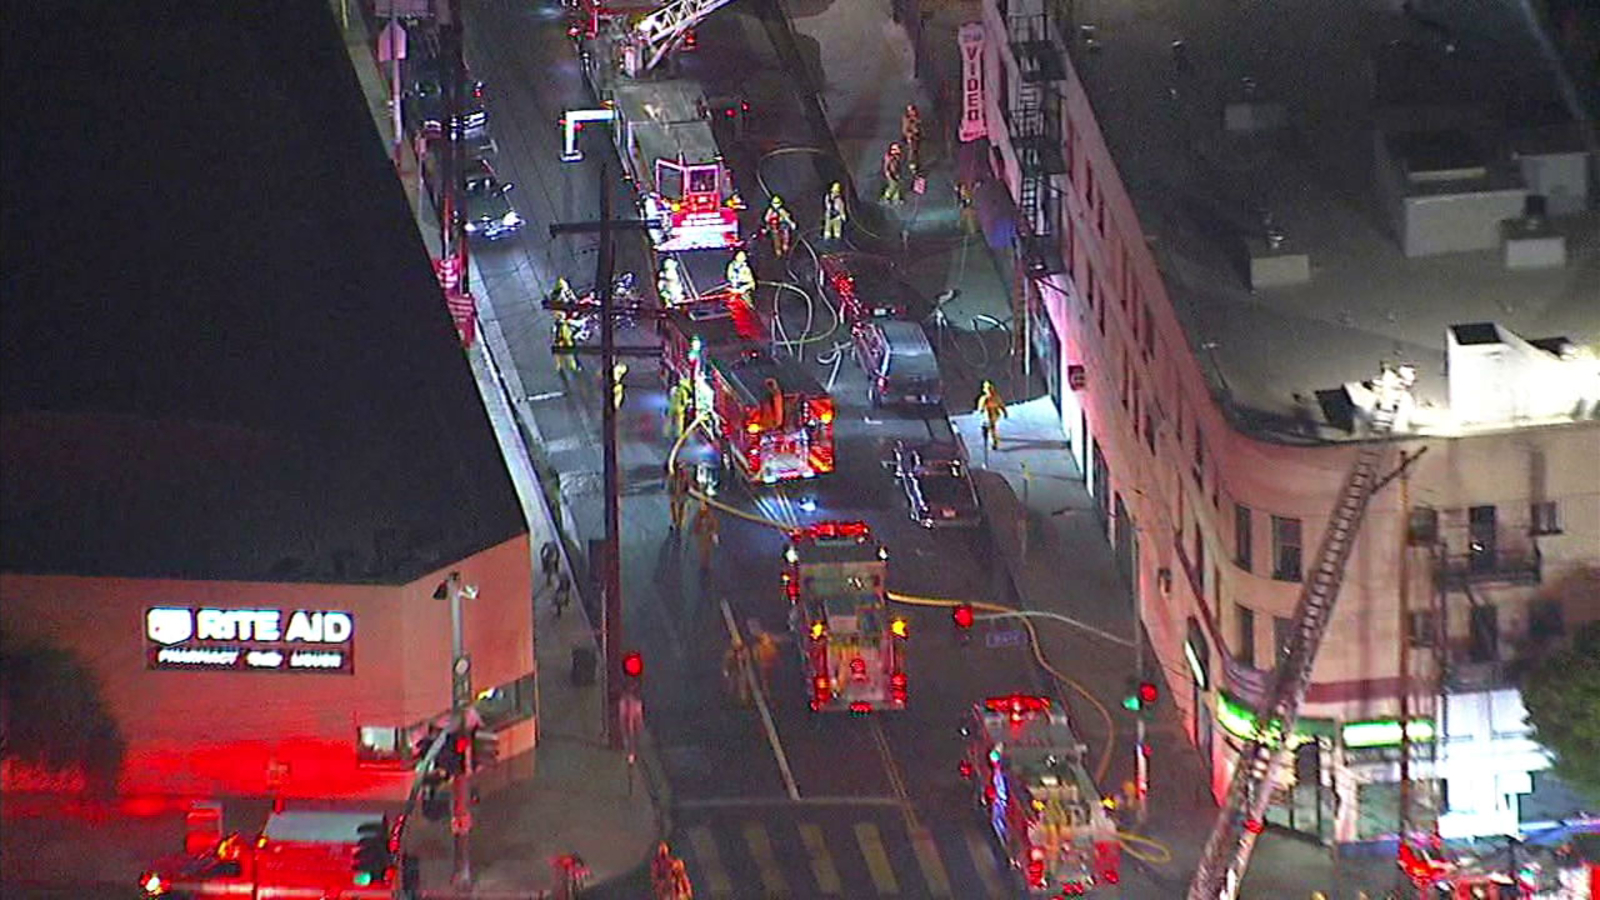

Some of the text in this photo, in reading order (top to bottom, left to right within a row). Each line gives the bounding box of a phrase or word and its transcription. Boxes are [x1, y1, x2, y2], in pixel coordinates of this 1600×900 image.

[966, 45, 979, 121] VIDEO
[196, 608, 353, 643] RITE AID
